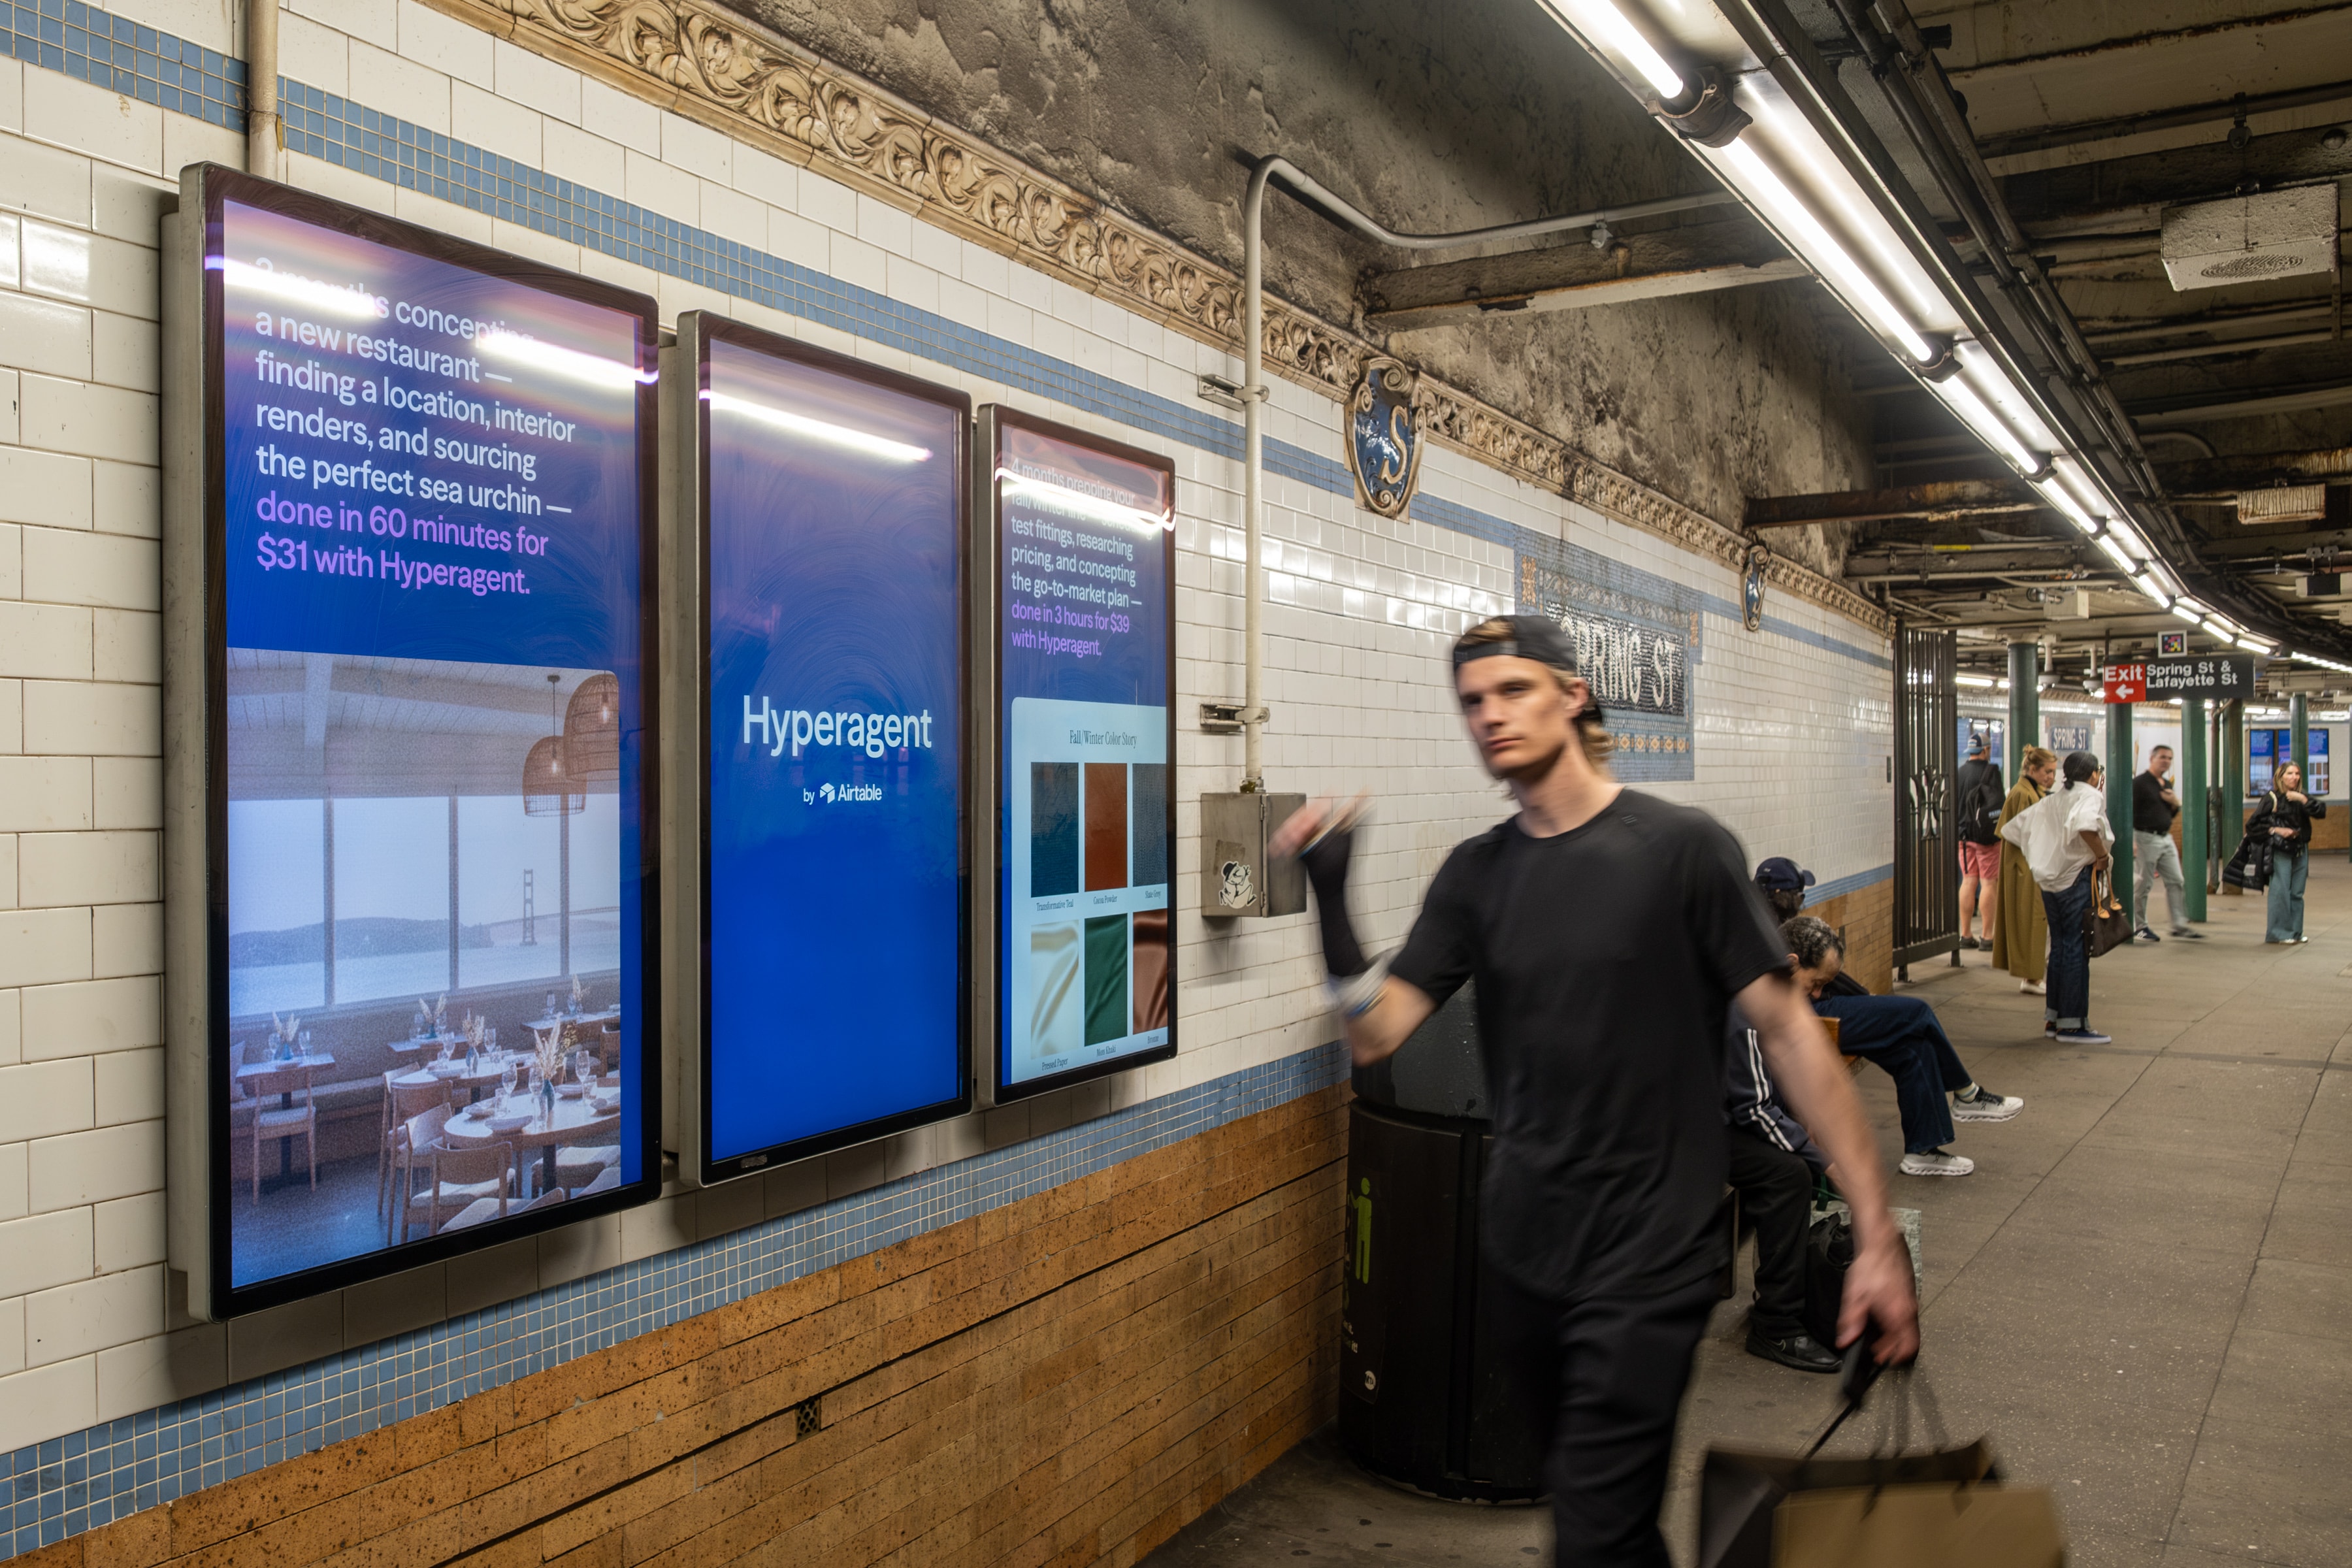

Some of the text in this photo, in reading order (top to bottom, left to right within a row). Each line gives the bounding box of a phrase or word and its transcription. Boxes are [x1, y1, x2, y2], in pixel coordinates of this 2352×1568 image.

[255, 312, 272, 336] a
[281, 316, 340, 350] new
[347, 332, 480, 384] restaurant
[255, 350, 576, 442] finding a location, interior
[257, 404, 536, 482] renders, and sourcing
[255, 444, 306, 480] the
[314, 459, 414, 497] perfect
[419, 477, 462, 504] sea
[469, 483, 541, 515] urchin
[1022, 464, 1064, 487] months
[1113, 488, 1135, 507] your
[257, 491, 548, 555] done in 60 minutes for
[1011, 515, 1034, 537] test
[1036, 519, 1074, 548] fittings,
[1077, 532, 1133, 562] researching
[257, 532, 530, 596] $31 with Hyperagent.
[1011, 544, 1136, 587] pricing, and concepting
[1011, 571, 1032, 592] the
[1034, 579, 1106, 604] go-to-market
[1108, 588, 1129, 609] plan
[1011, 599, 1130, 634] done in 3 hours for $39
[1012, 629, 1102, 658] with Hyperagent.
[1652, 638, 1676, 708] ST
[2104, 664, 2142, 682] Exit
[2147, 660, 2231, 678] Spring St &
[2147, 672, 2238, 689] Lafayette St
[743, 694, 932, 758] Hyperagent
[1070, 730, 1137, 749] Fall/Winter Color Story
[2053, 727, 2086, 749] SPRING ST
[803, 783, 882, 806] by Airtable
[1036, 900, 1066, 911] Transformative
[1093, 894, 1118, 905] Cocoa Powder
[1041, 1058, 1068, 1071] Pressed Paper
